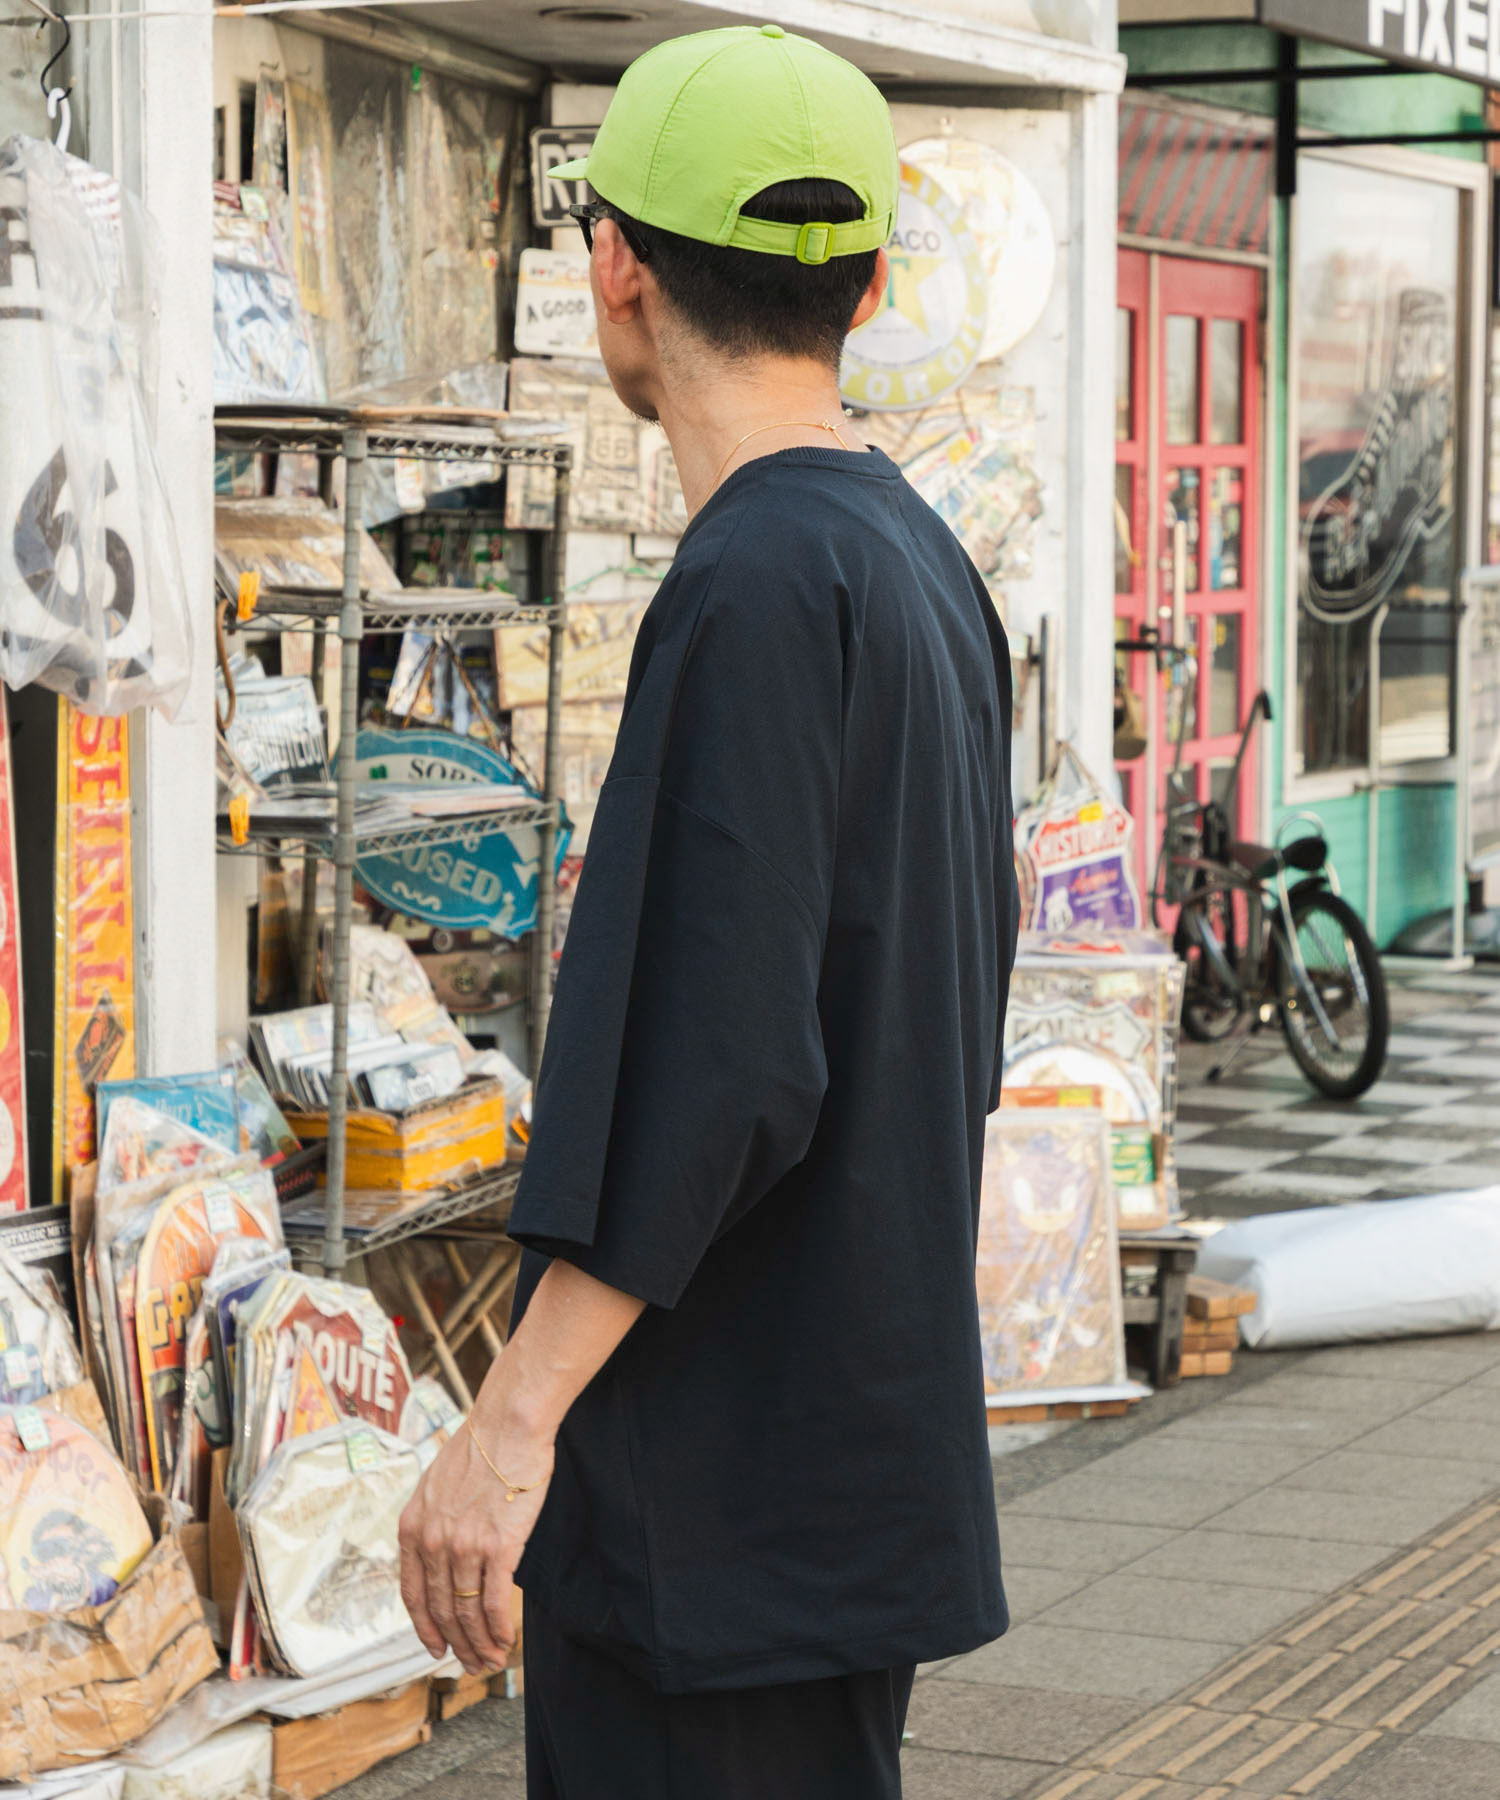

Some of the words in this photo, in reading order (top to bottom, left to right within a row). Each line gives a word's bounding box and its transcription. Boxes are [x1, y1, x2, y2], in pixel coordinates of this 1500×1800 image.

[889, 230, 941, 251] ACO
[408, 757, 482, 784] SOR
[382, 843, 502, 906] OSED
